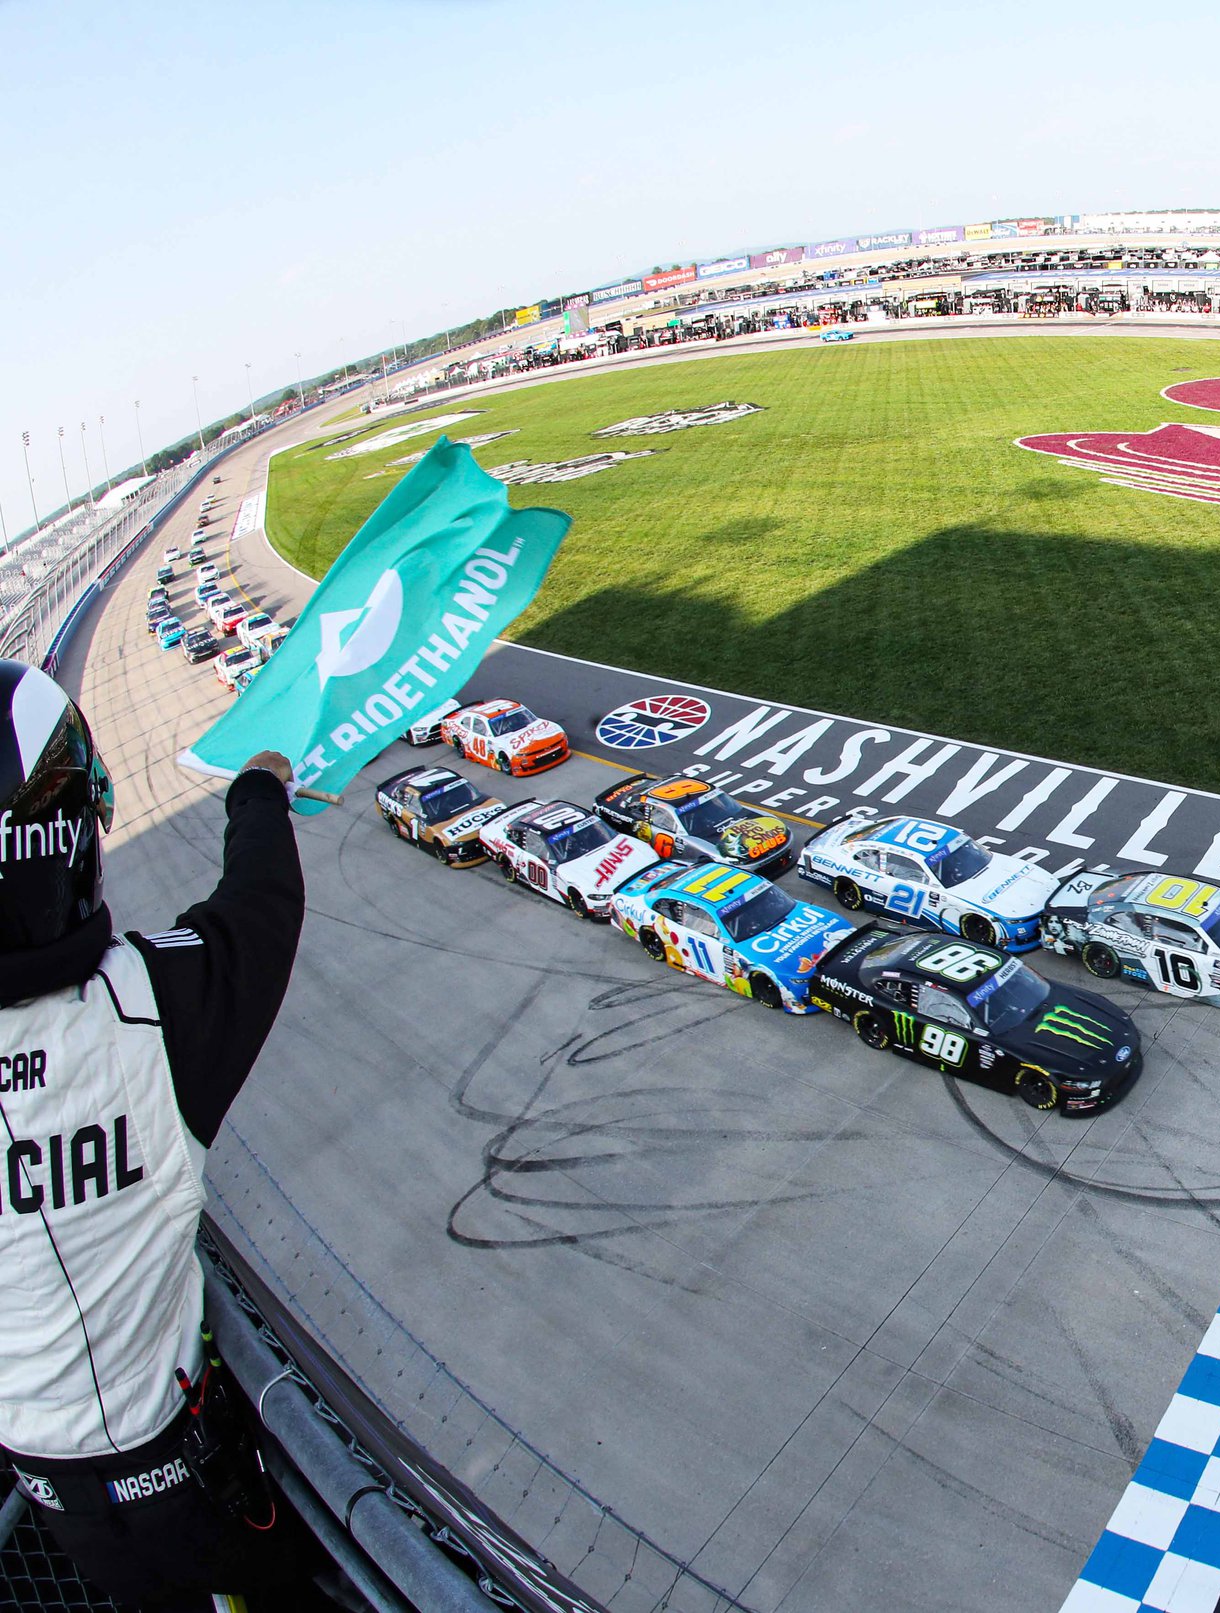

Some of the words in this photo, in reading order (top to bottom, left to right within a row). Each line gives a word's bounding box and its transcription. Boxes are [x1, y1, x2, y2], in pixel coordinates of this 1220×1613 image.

[815, 242, 847, 256] xfinity
[871, 233, 909, 245] RACKLEY
[699, 260, 747, 276] GEICO
[766, 252, 787, 265] ally
[657, 271, 695, 286] DOORDASH
[473, 735, 486, 758] 48
[293, 744, 337, 788] ET
[649, 779, 711, 800] 8
[410, 817, 419, 840] 1
[446, 806, 503, 837] HUCK'S
[731, 820, 758, 835] Bass
[743, 826, 763, 838] Pro
[751, 825, 785, 844] Shops
[895, 820, 947, 851] 21
[0, 808, 82, 869] finity
[747, 833, 787, 859] CLUB
[528, 860, 548, 890] 00
[812, 855, 885, 883] BENNETT
[987, 865, 1032, 900] BENNETT
[682, 866, 752, 903] 11
[888, 883, 927, 916] 21
[1146, 877, 1218, 918] 10
[615, 897, 646, 924] Cirkul
[722, 898, 742, 914] xfinity
[751, 906, 825, 953] Cirkul
[686, 935, 718, 977] 11
[918, 943, 1000, 981] 98
[999, 959, 1019, 981] HERBST
[1154, 948, 1199, 991] 10
[820, 974, 874, 1008] MONSTER
[972, 982, 995, 1001] xfinity
[921, 1025, 966, 1065] 98
[0, 1049, 47, 1092] CAR
[0, 1114, 144, 1215] CIAL
[113, 1458, 191, 1503] NASCAR
